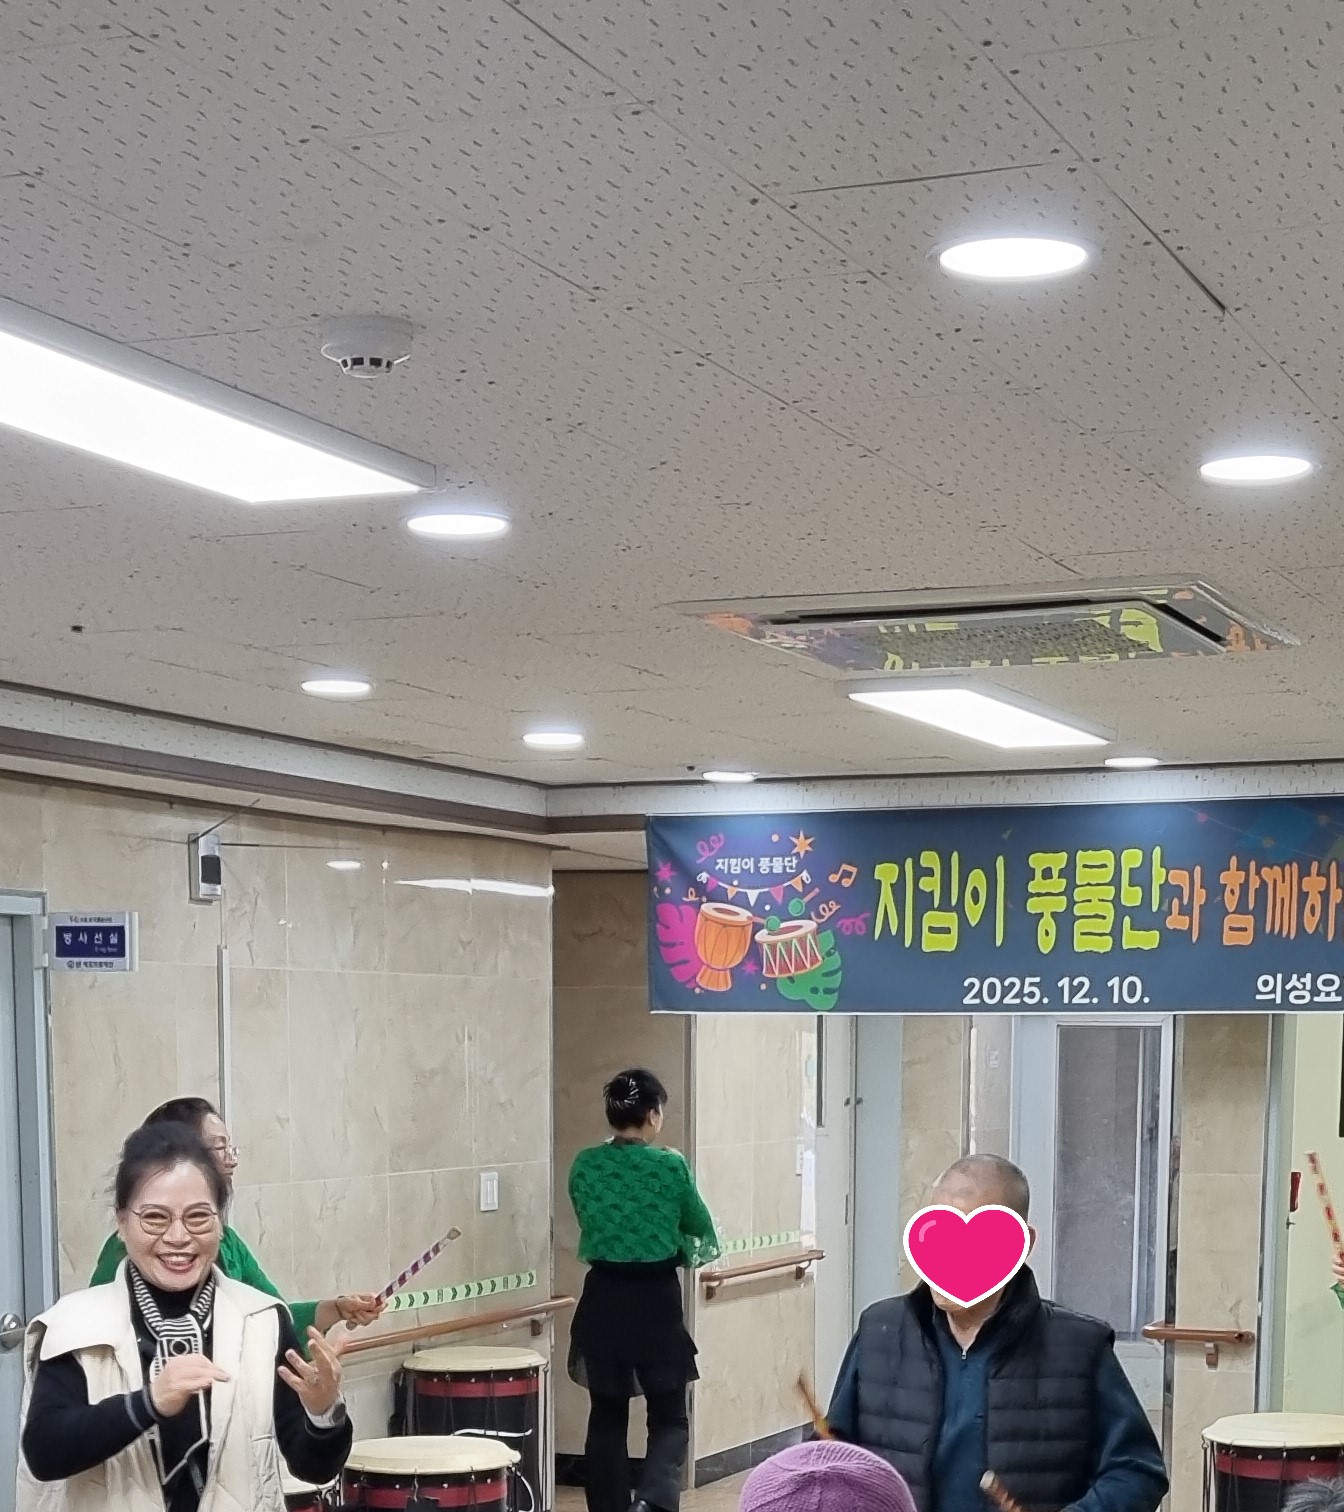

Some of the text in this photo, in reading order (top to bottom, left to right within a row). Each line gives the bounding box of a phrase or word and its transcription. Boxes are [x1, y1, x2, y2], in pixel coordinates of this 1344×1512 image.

[715, 856, 798, 873] 지킴이 풍물단
[873, 850, 1005, 952] 지킴이
[1026, 848, 1207, 953] 풍물단과
[961, 975, 1151, 1005] 2025. 12. 10.
